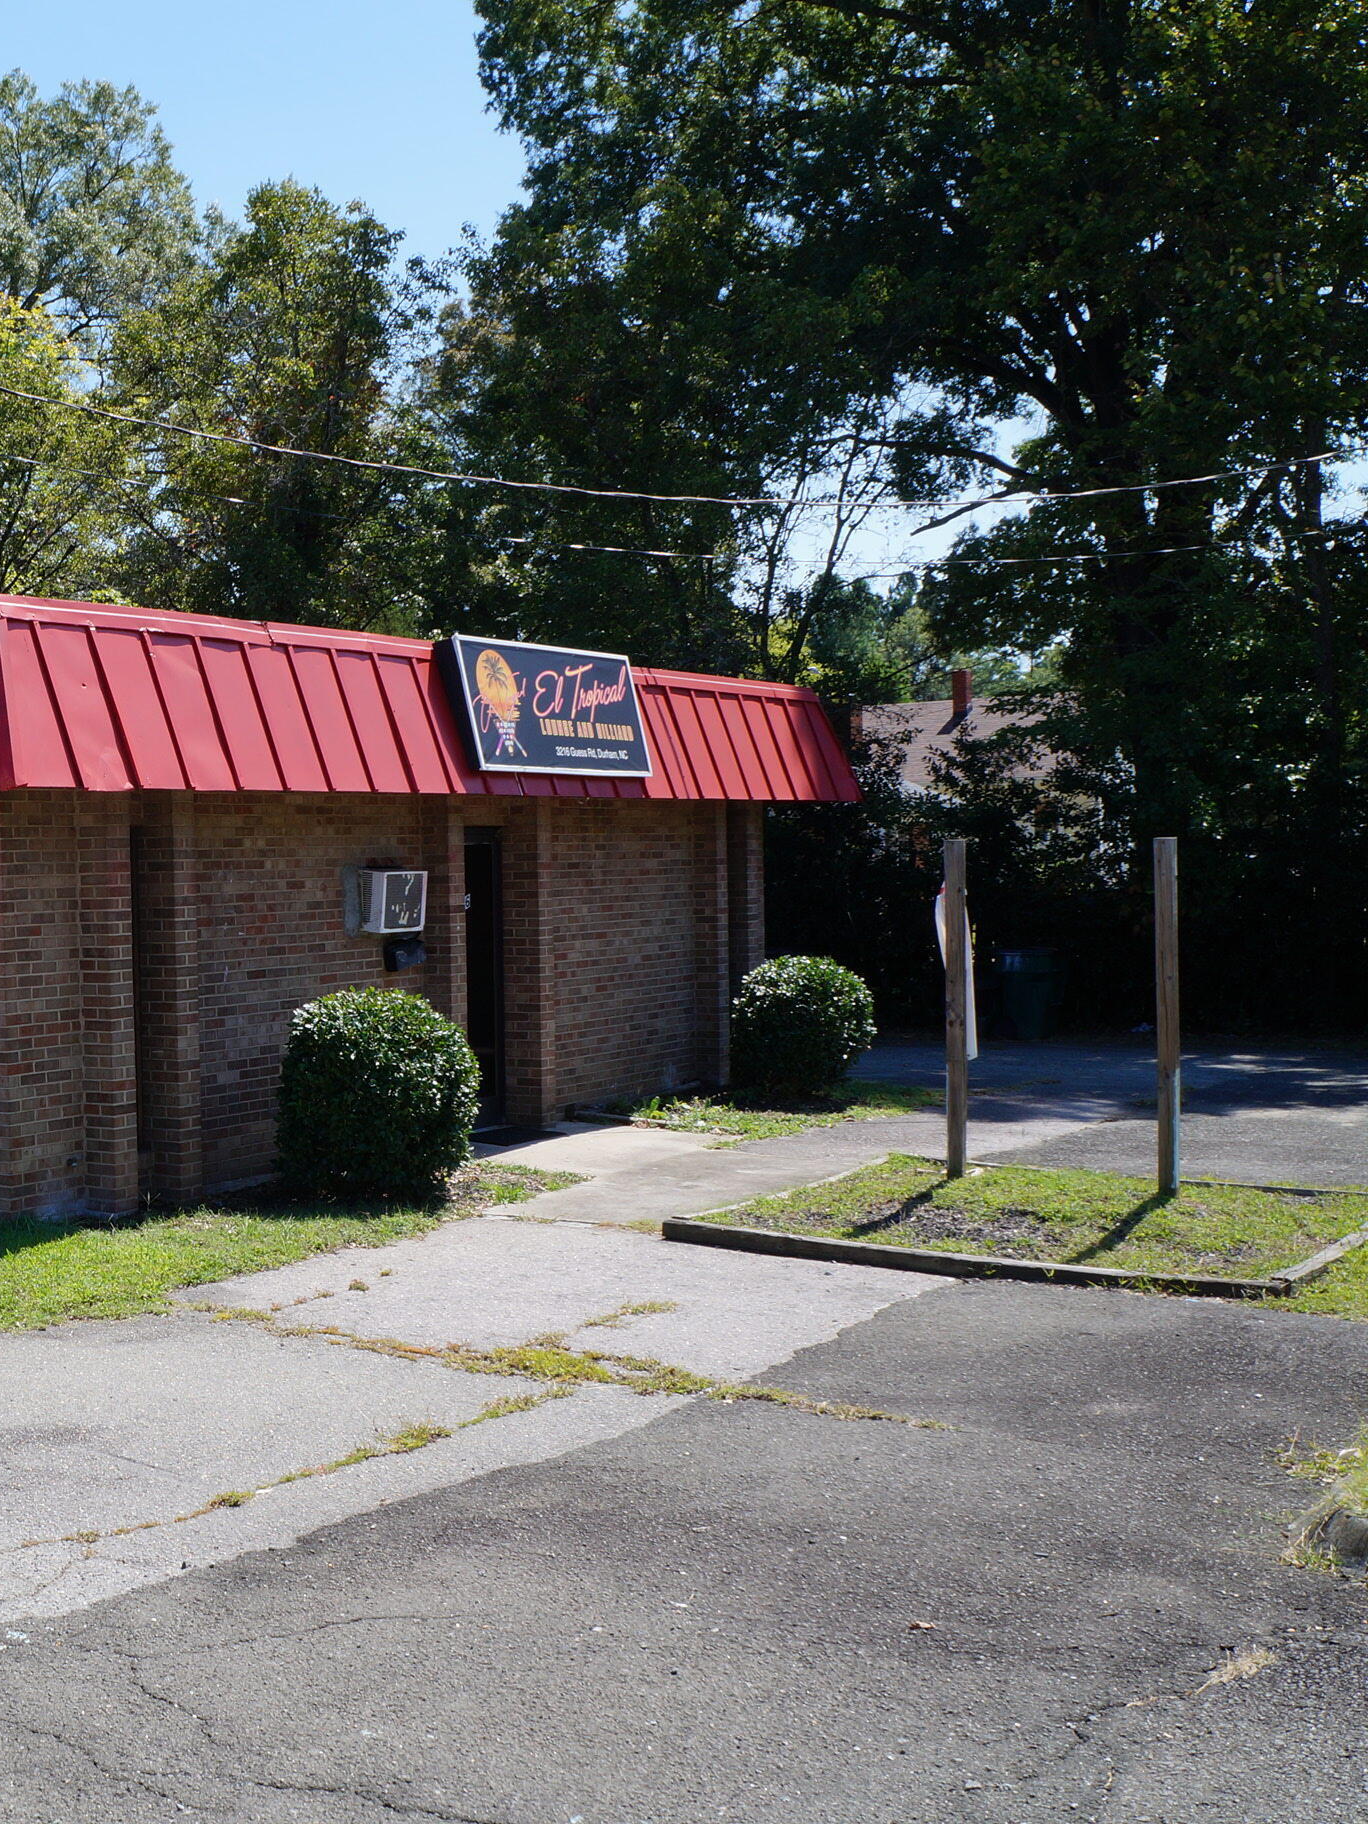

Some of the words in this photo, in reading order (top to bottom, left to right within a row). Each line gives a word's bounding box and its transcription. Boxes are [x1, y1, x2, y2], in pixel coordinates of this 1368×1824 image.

[532, 670, 564, 717] El
[565, 663, 626, 722] Tropical
[539, 718, 575, 737] LOUNGE
[577, 721, 594, 738] AND
[595, 722, 634, 741] BILLIARD
[619, 749, 629, 760] NC
